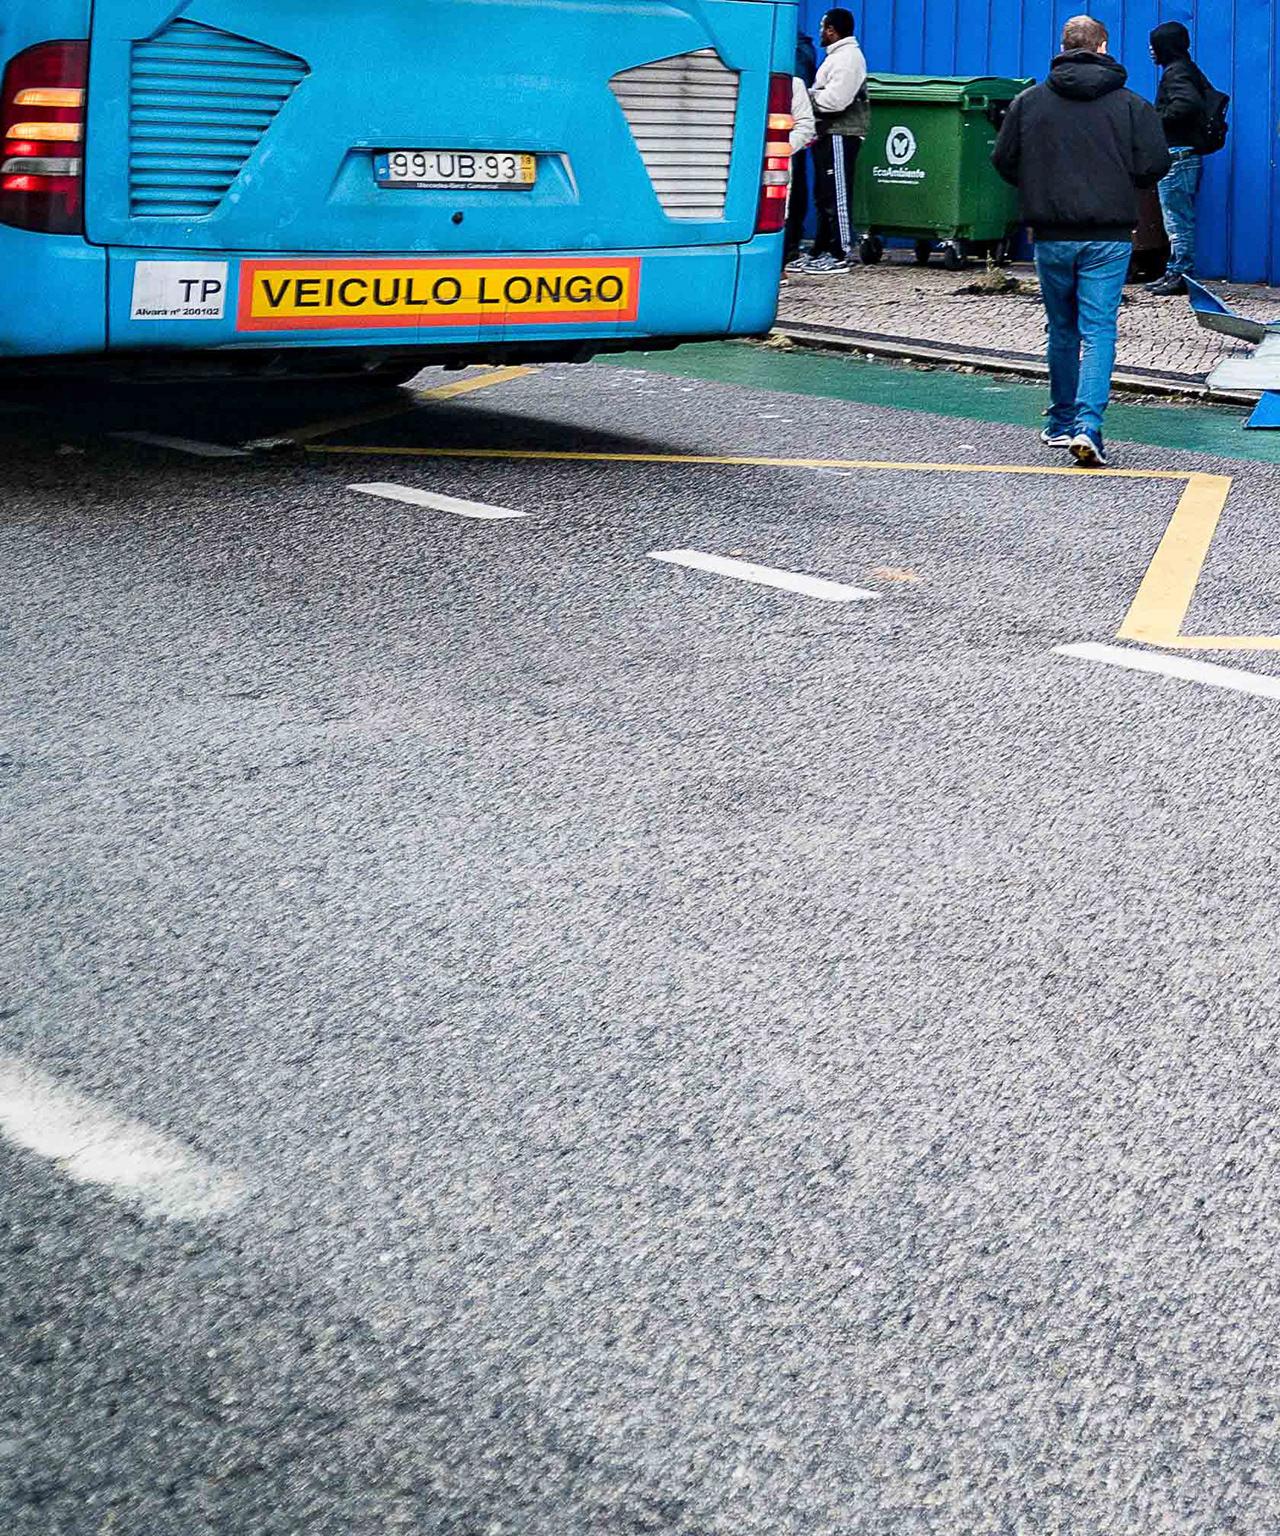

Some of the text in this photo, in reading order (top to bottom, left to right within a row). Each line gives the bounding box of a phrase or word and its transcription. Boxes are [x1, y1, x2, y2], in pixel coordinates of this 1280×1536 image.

[178, 279, 222, 302] TP
[261, 275, 624, 308] VEICULO LONGO
